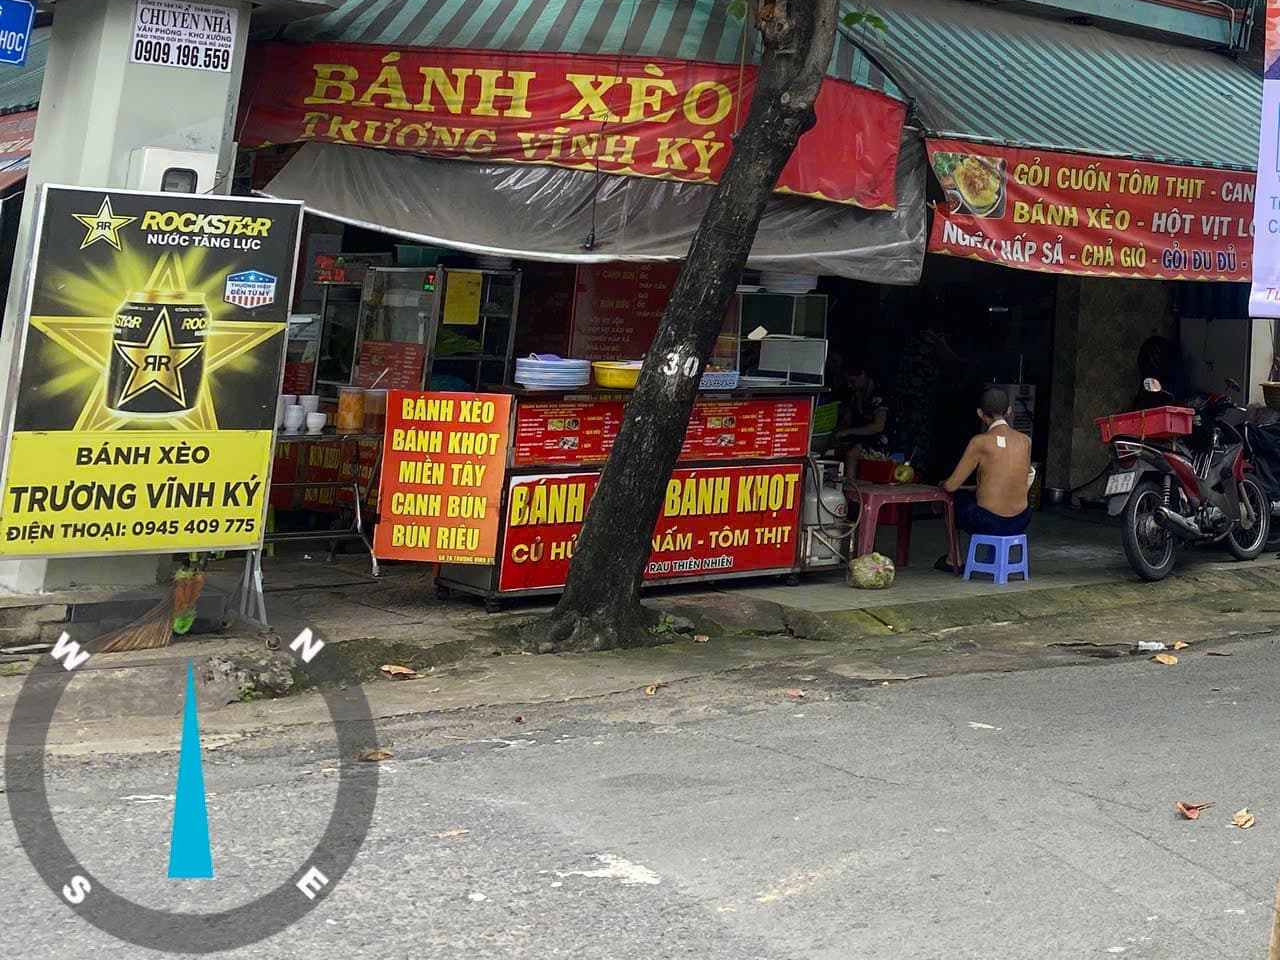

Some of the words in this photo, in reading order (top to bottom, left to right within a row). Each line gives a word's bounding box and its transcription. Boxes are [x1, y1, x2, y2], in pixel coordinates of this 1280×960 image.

[202, 12, 232, 34] NHÀ
[134, 39, 230, 70] 0909.196.559
[303, 51, 536, 118] BÁNH
[560, 63, 733, 125] XÈO
[652, 130, 725, 174] KÝ
[1012, 157, 1050, 187] GỎI
[1056, 161, 1111, 192] CUỐN
[1117, 170, 1159, 197] TÔM
[1165, 176, 1206, 203] THỊT
[141, 211, 271, 237] ROCKSTAR
[1013, 200, 1079, 228] BÁNH
[1086, 204, 1132, 232] XÈO
[1152, 211, 1194, 237] HỘT
[1201, 215, 1232, 240] VỊT
[147, 233, 190, 246] NƯỚC
[193, 234, 230, 248] TĂNG
[234, 237, 261, 252] LỰC
[1000, 229, 1037, 263] HẤP
[1041, 235, 1064, 265] SẢ
[1081, 239, 1115, 267] CHẢ
[1120, 241, 1147, 268] GIÒ
[1162, 241, 1188, 270] GỎI
[402, 395, 454, 422] BÁNH
[458, 397, 495, 424] XÈO
[75, 441, 151, 465] BÁNH
[157, 441, 210, 465] XÈO
[392, 426, 443, 453] BÁNH
[447, 431, 501, 460] KHỌT
[398, 455, 445, 485] MIỀN
[451, 460, 487, 487] TÂY
[8, 480, 137, 514] TRƯƠNG
[146, 476, 216, 509] VĨNH
[222, 474, 262, 508] KÝ
[391, 492, 442, 517] CANH
[447, 493, 487, 519] BÚN
[510, 478, 586, 527] BÁNH
[664, 472, 731, 517] BÁNH
[737, 473, 800, 518] KHỌT
[6, 520, 55, 544] ĐIỆN
[60, 522, 127, 541] THOẠI:
[131, 519, 180, 536] 0945
[184, 518, 219, 534] 409
[224, 517, 256, 534] 775
[392, 521, 431, 549] BÚN
[436, 523, 481, 551] RIÊU
[511, 535, 544, 564] CỦ
[709, 525, 749, 549] TÔM
[755, 525, 792, 549] THỊT
[648, 560, 670, 573] RAU
[673, 557, 702, 572] THIÊN
[703, 556, 734, 570] NHIÊN
